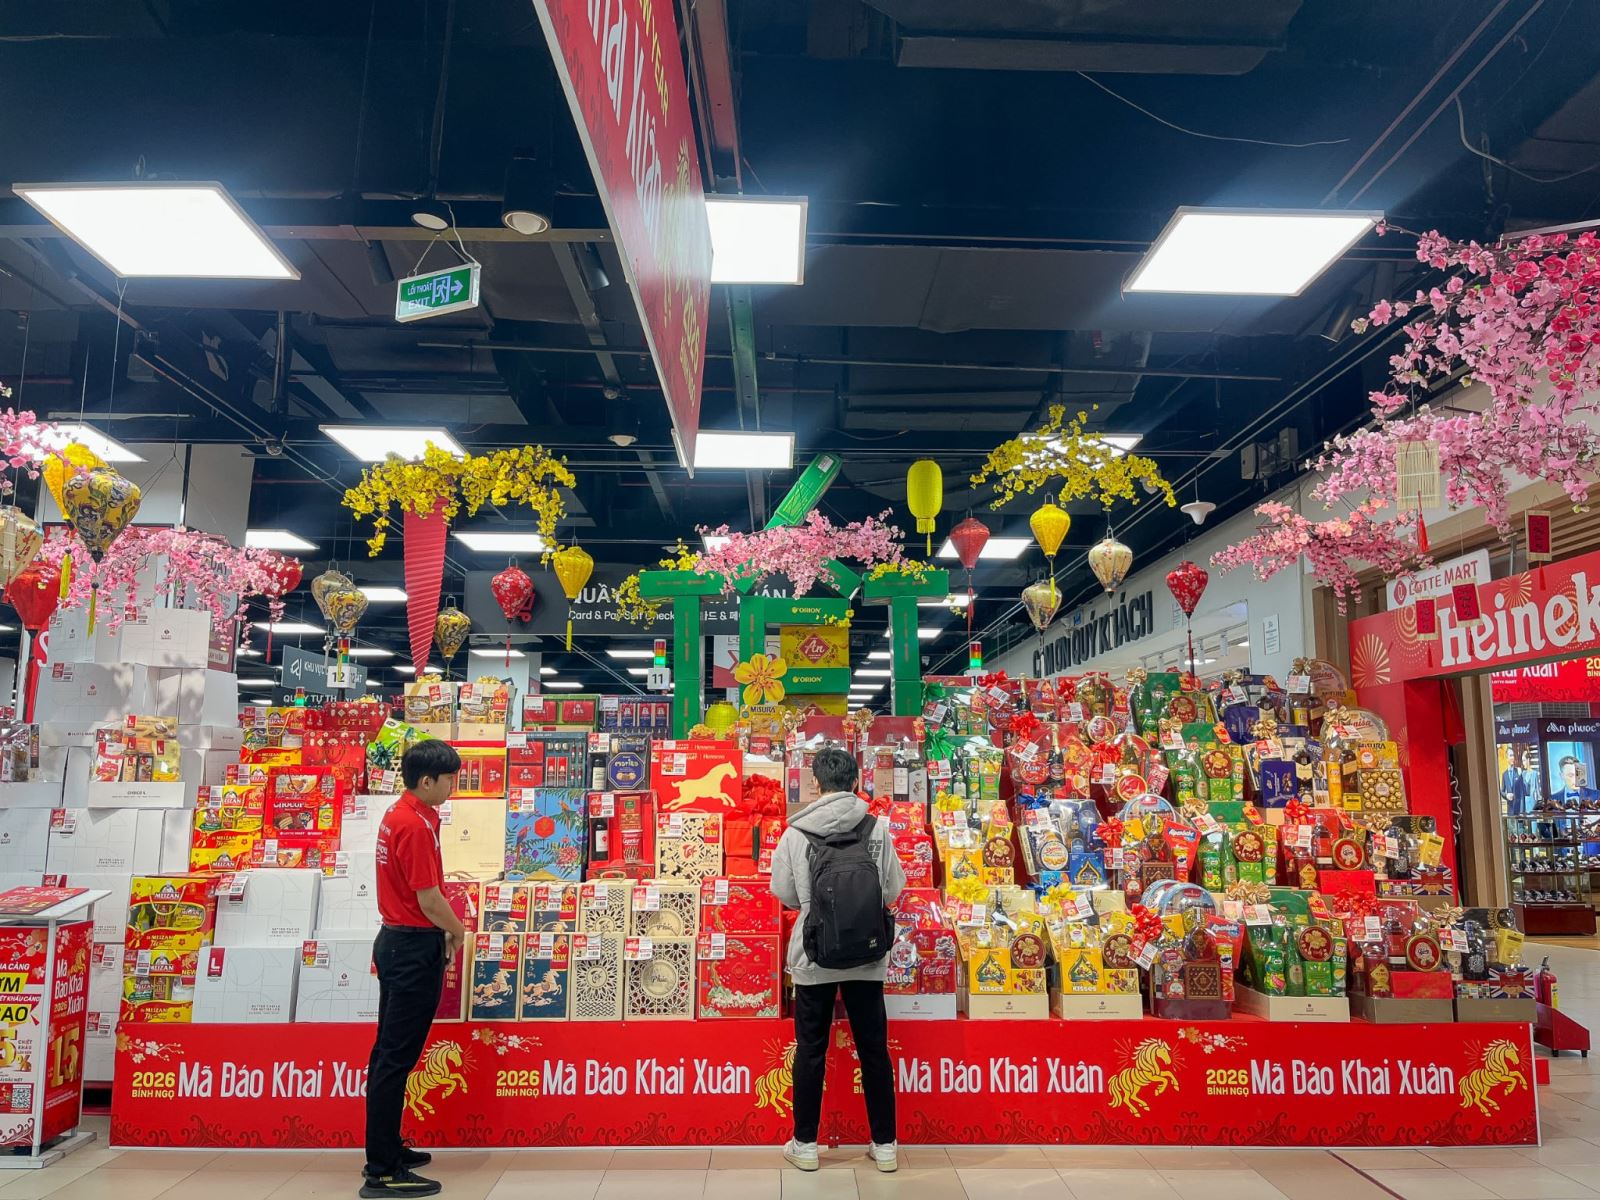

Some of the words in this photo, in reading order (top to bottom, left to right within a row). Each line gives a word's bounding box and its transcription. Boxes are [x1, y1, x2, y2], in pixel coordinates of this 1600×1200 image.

[409, 297, 430, 309] EXIT
[1409, 574, 1442, 596] LOTTE
[1444, 559, 1479, 586] MART
[569, 610, 593, 620] Card
[594, 611, 602, 620] &
[1072, 610, 1099, 665] QUÝ
[804, 639, 825, 654] An
[331, 671, 345, 683] 12
[651, 674, 664, 685] 11
[8, 961, 30, 971] CÀNG
[56, 958, 68, 979] Mã
[0, 976, 21, 993] M
[69, 973, 84, 995] Khai
[0, 1006, 29, 1022] AO
[132, 1072, 175, 1088] 2026
[178, 1061, 213, 1098] Mã
[220, 1061, 264, 1098] Đáo
[271, 1060, 324, 1098] Khai
[330, 1061, 370, 1098] Xuâ
[496, 1070, 540, 1086] 2026
[542, 1059, 577, 1096] Mã
[584, 1059, 628, 1096] Đáo
[635, 1058, 685, 1096] Khai
[693, 1058, 750, 1095] Xuân
[898, 1057, 932, 1093] Mã
[940, 1057, 982, 1093] Đáo
[990, 1056, 1039, 1093] Khai
[1046, 1057, 1103, 1093] Xuân
[1206, 1069, 1248, 1085] 2026
[1250, 1059, 1285, 1095] Mã
[1291, 1059, 1334, 1095] Đáo
[1341, 1058, 1391, 1095] Khai
[1397, 1059, 1455, 1095] Xuân
[154, 1089, 175, 1101] NGỌ
[519, 1087, 540, 1099] NGỌ
[1229, 1086, 1250, 1097] NGỌ
